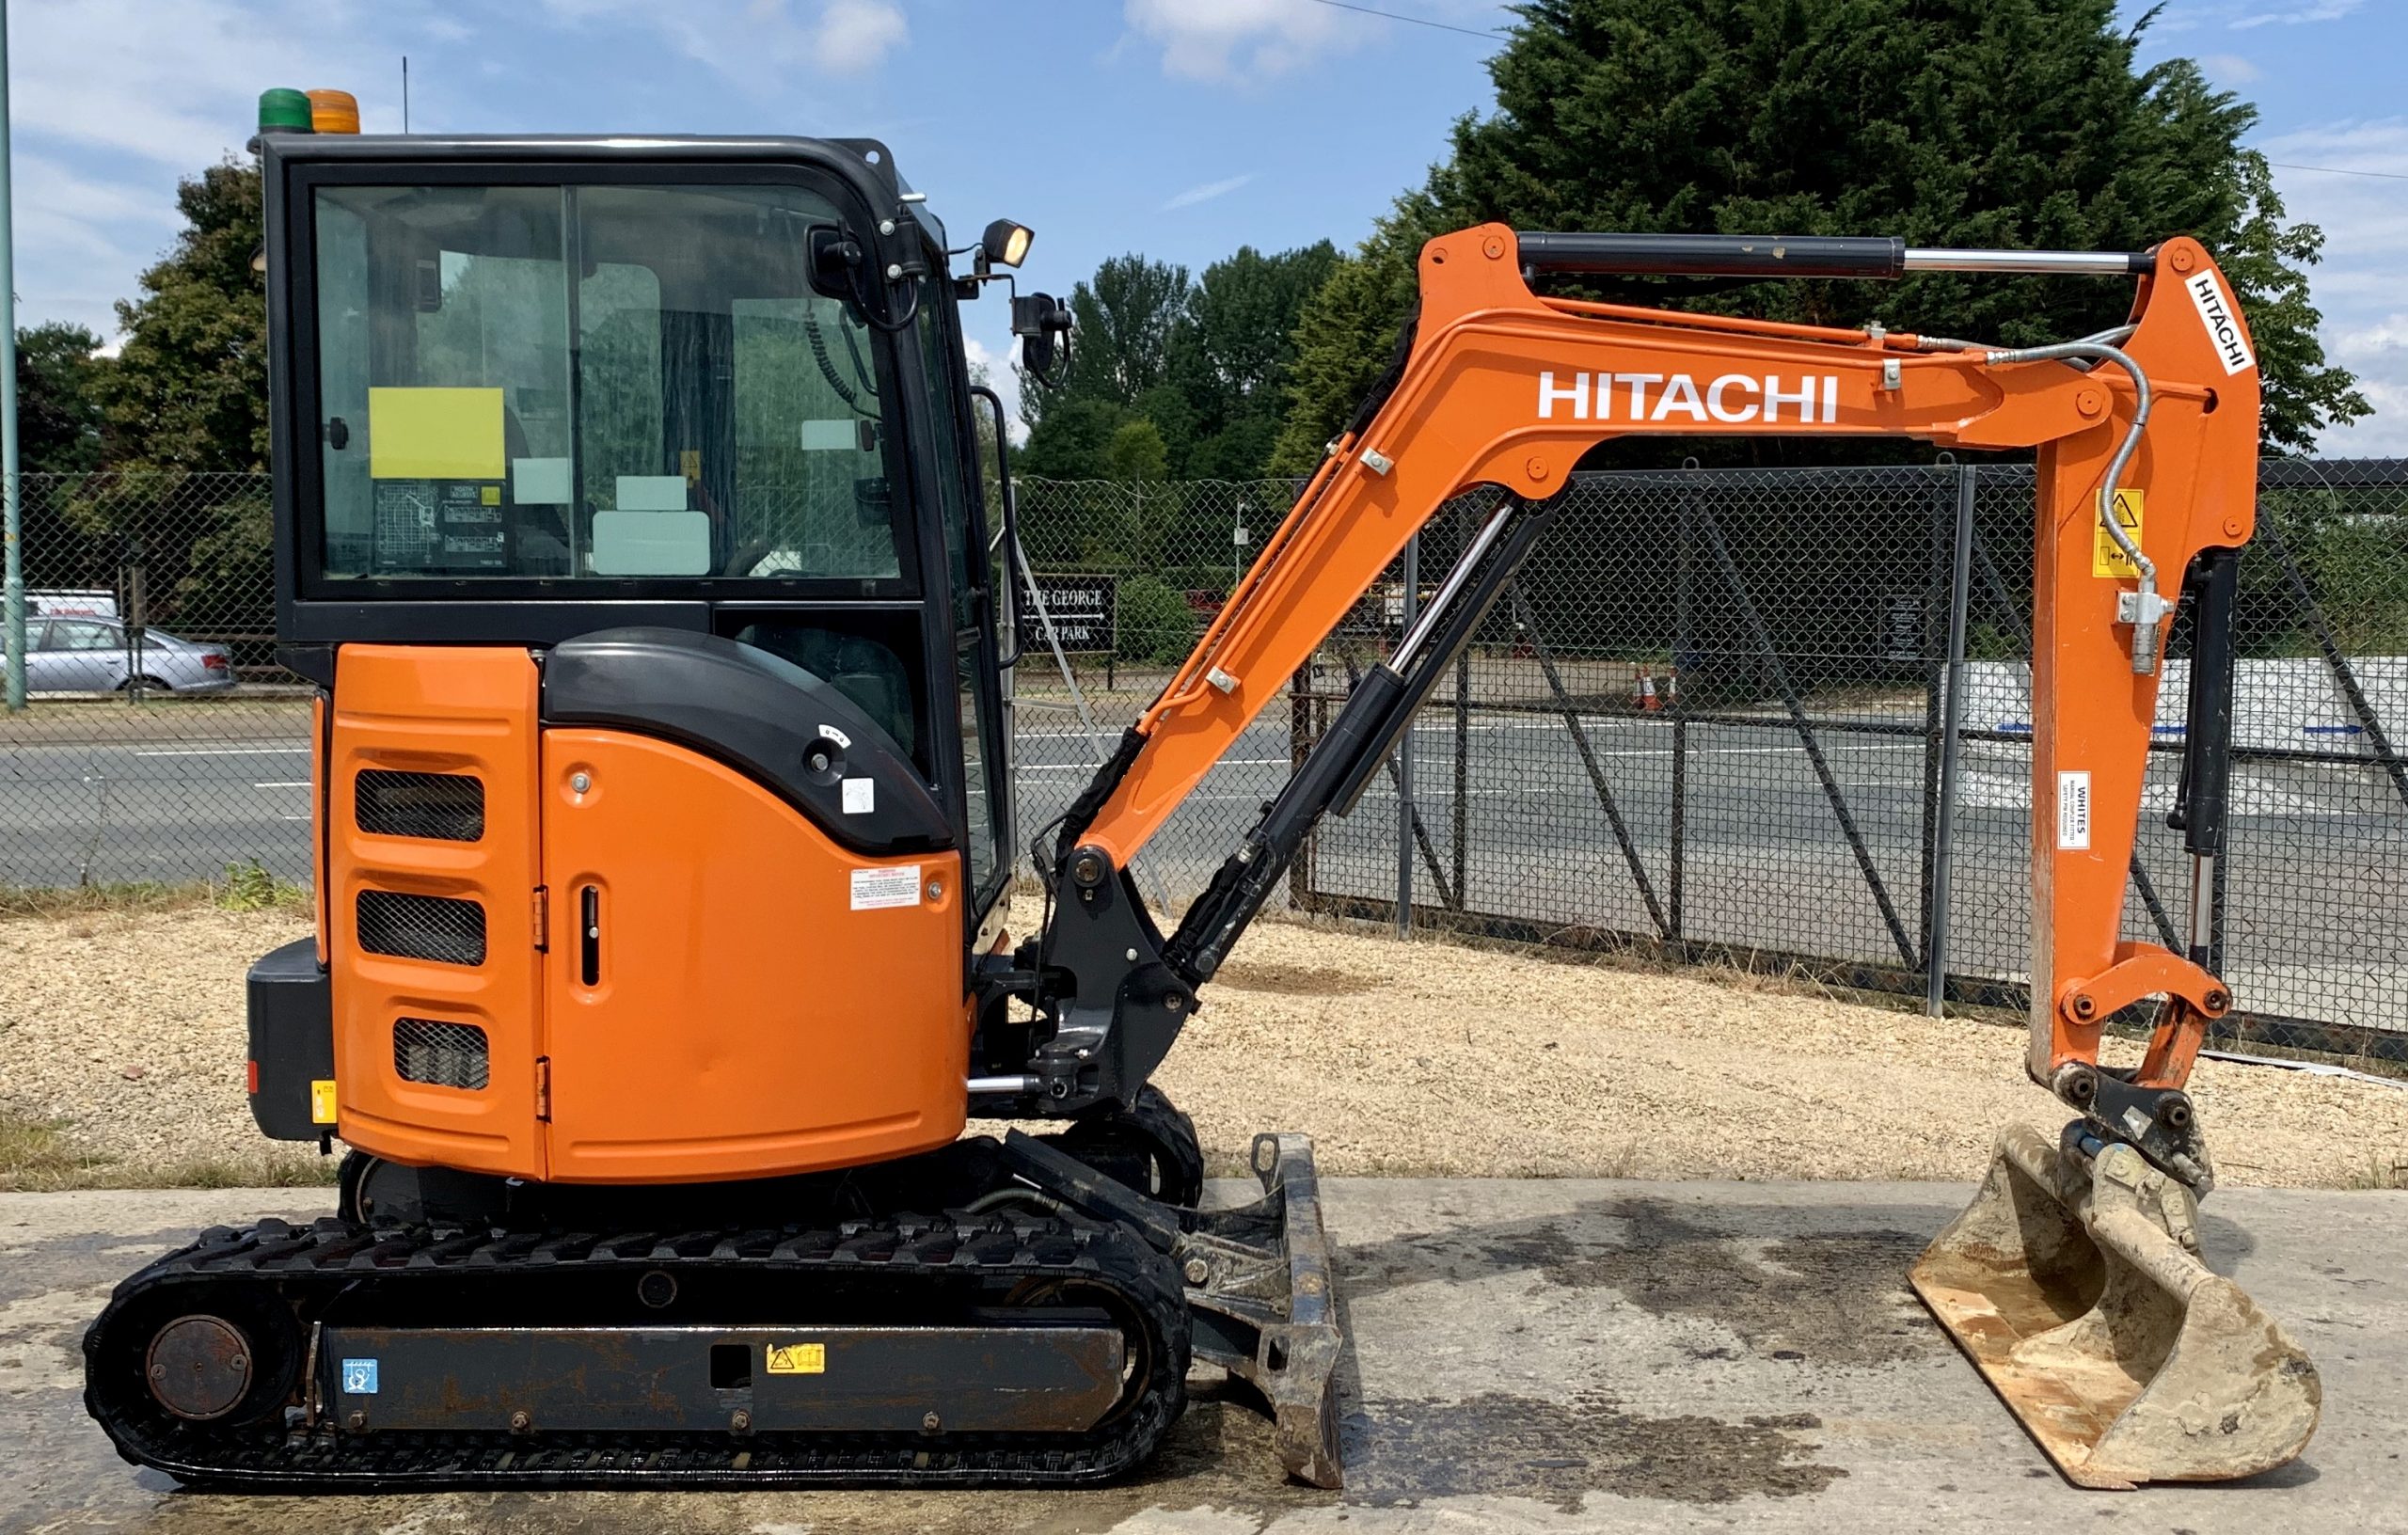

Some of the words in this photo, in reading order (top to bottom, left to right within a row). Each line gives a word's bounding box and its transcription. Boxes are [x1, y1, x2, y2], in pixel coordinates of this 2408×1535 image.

[2194, 278, 2246, 367] HITACHI
[1538, 372, 1838, 423] HITACHI
[1053, 589, 1102, 607] GEORGE
[1061, 625, 1090, 641] PARK
[2077, 786, 2086, 834] WHITES
